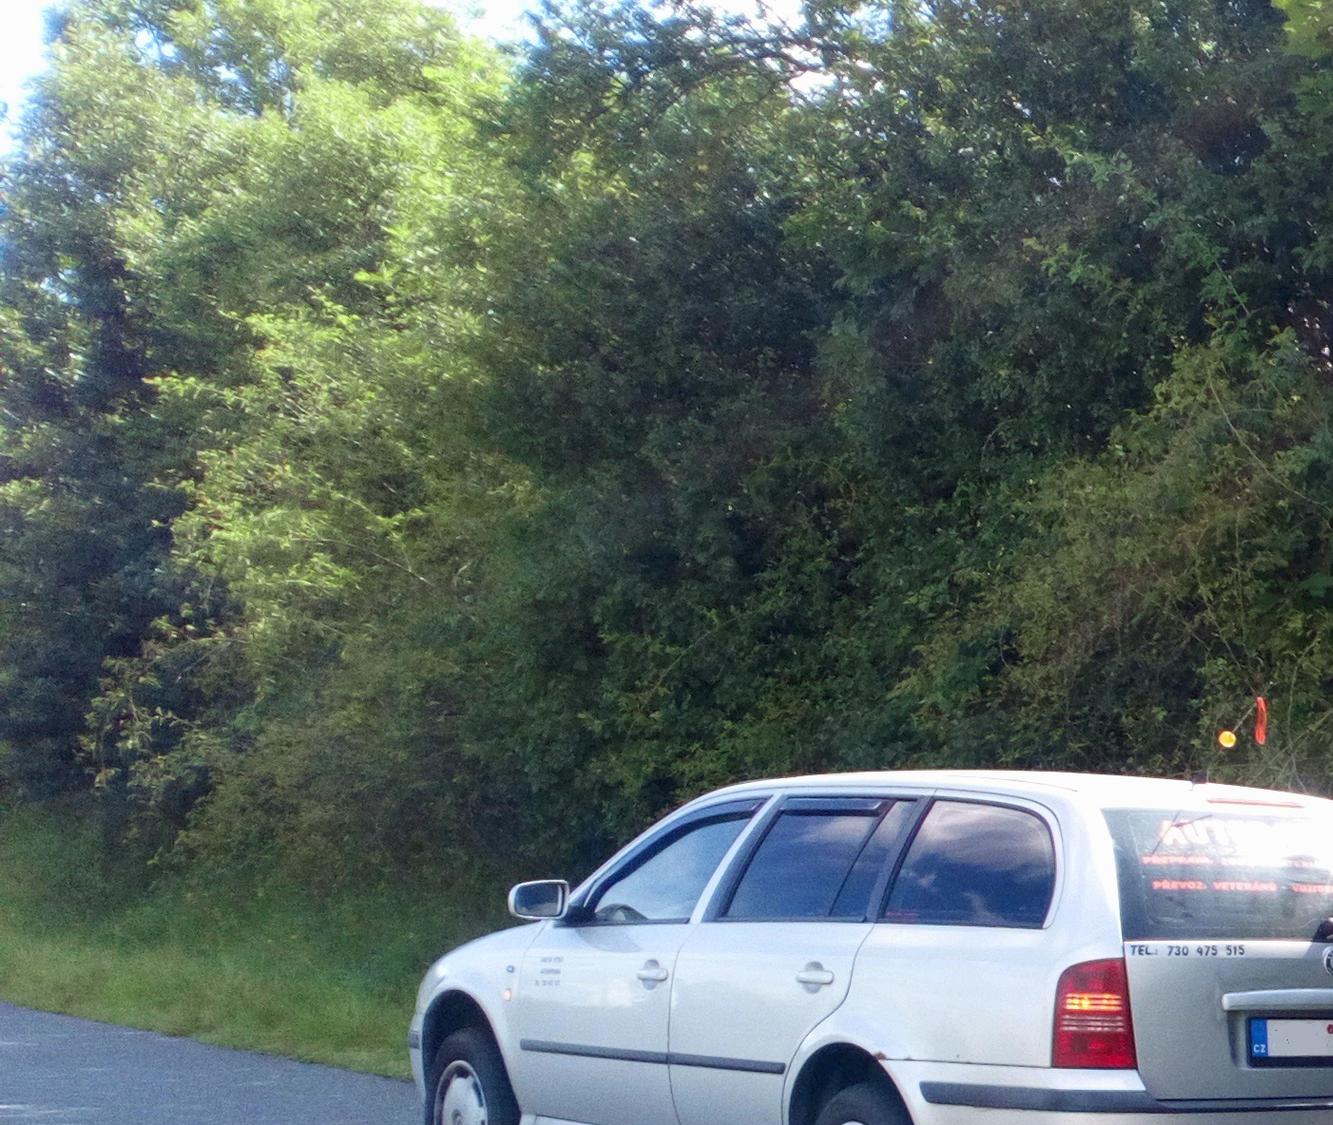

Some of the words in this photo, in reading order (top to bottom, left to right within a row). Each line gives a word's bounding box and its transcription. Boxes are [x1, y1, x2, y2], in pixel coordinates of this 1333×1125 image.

[1167, 945, 1189, 956] 730
[1196, 945, 1218, 956] 475
[1226, 945, 1245, 956] 515
[1253, 1043, 1266, 1053] CZ
